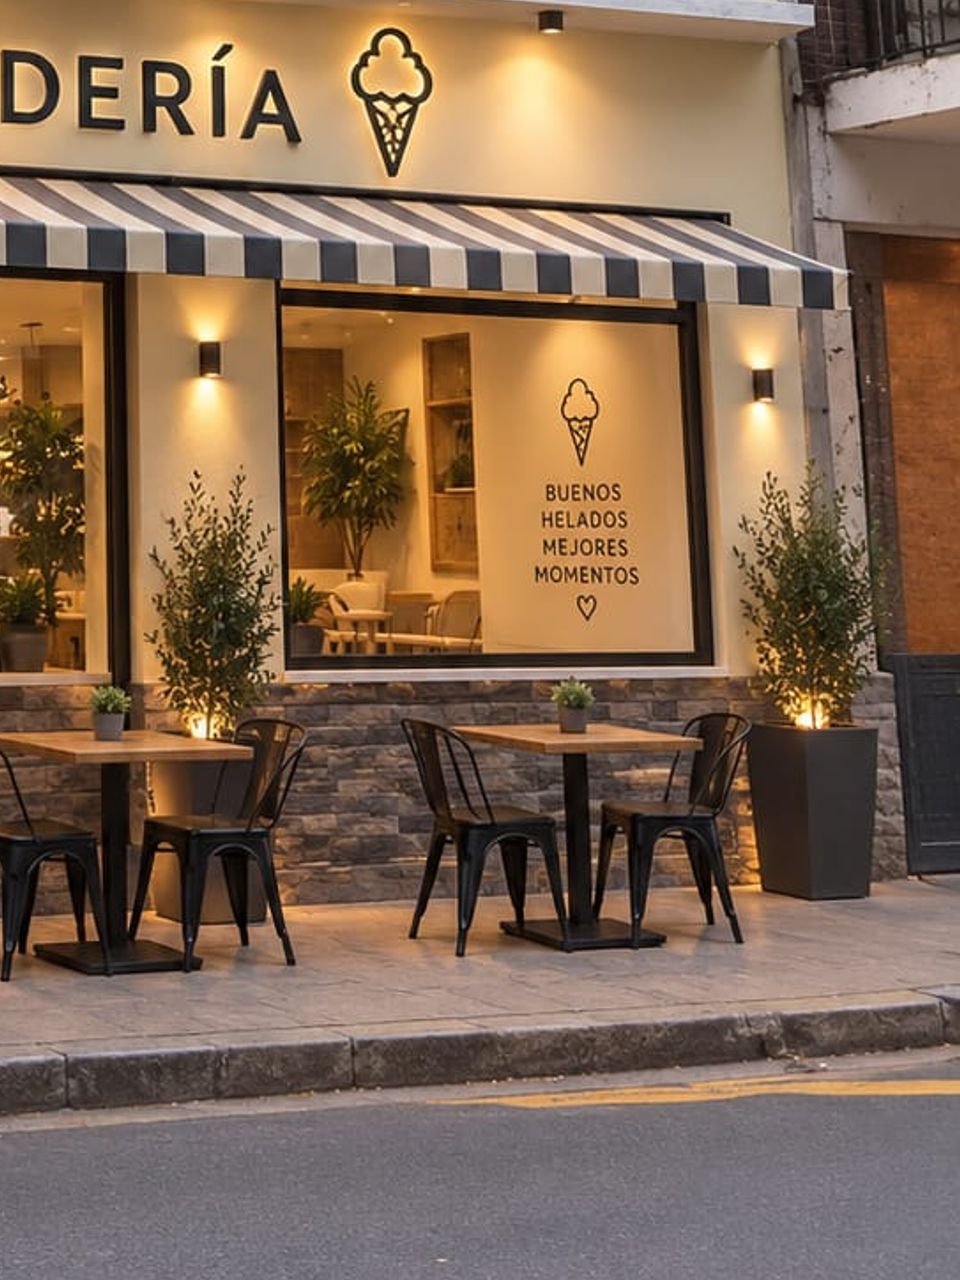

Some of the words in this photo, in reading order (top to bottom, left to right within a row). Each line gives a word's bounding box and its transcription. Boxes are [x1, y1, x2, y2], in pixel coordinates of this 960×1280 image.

[545, 483, 622, 502] BUENOS
[541, 510, 628, 529] HELADOS
[543, 538, 629, 557] MEJORES
[534, 566, 640, 585] MOMENTOS
